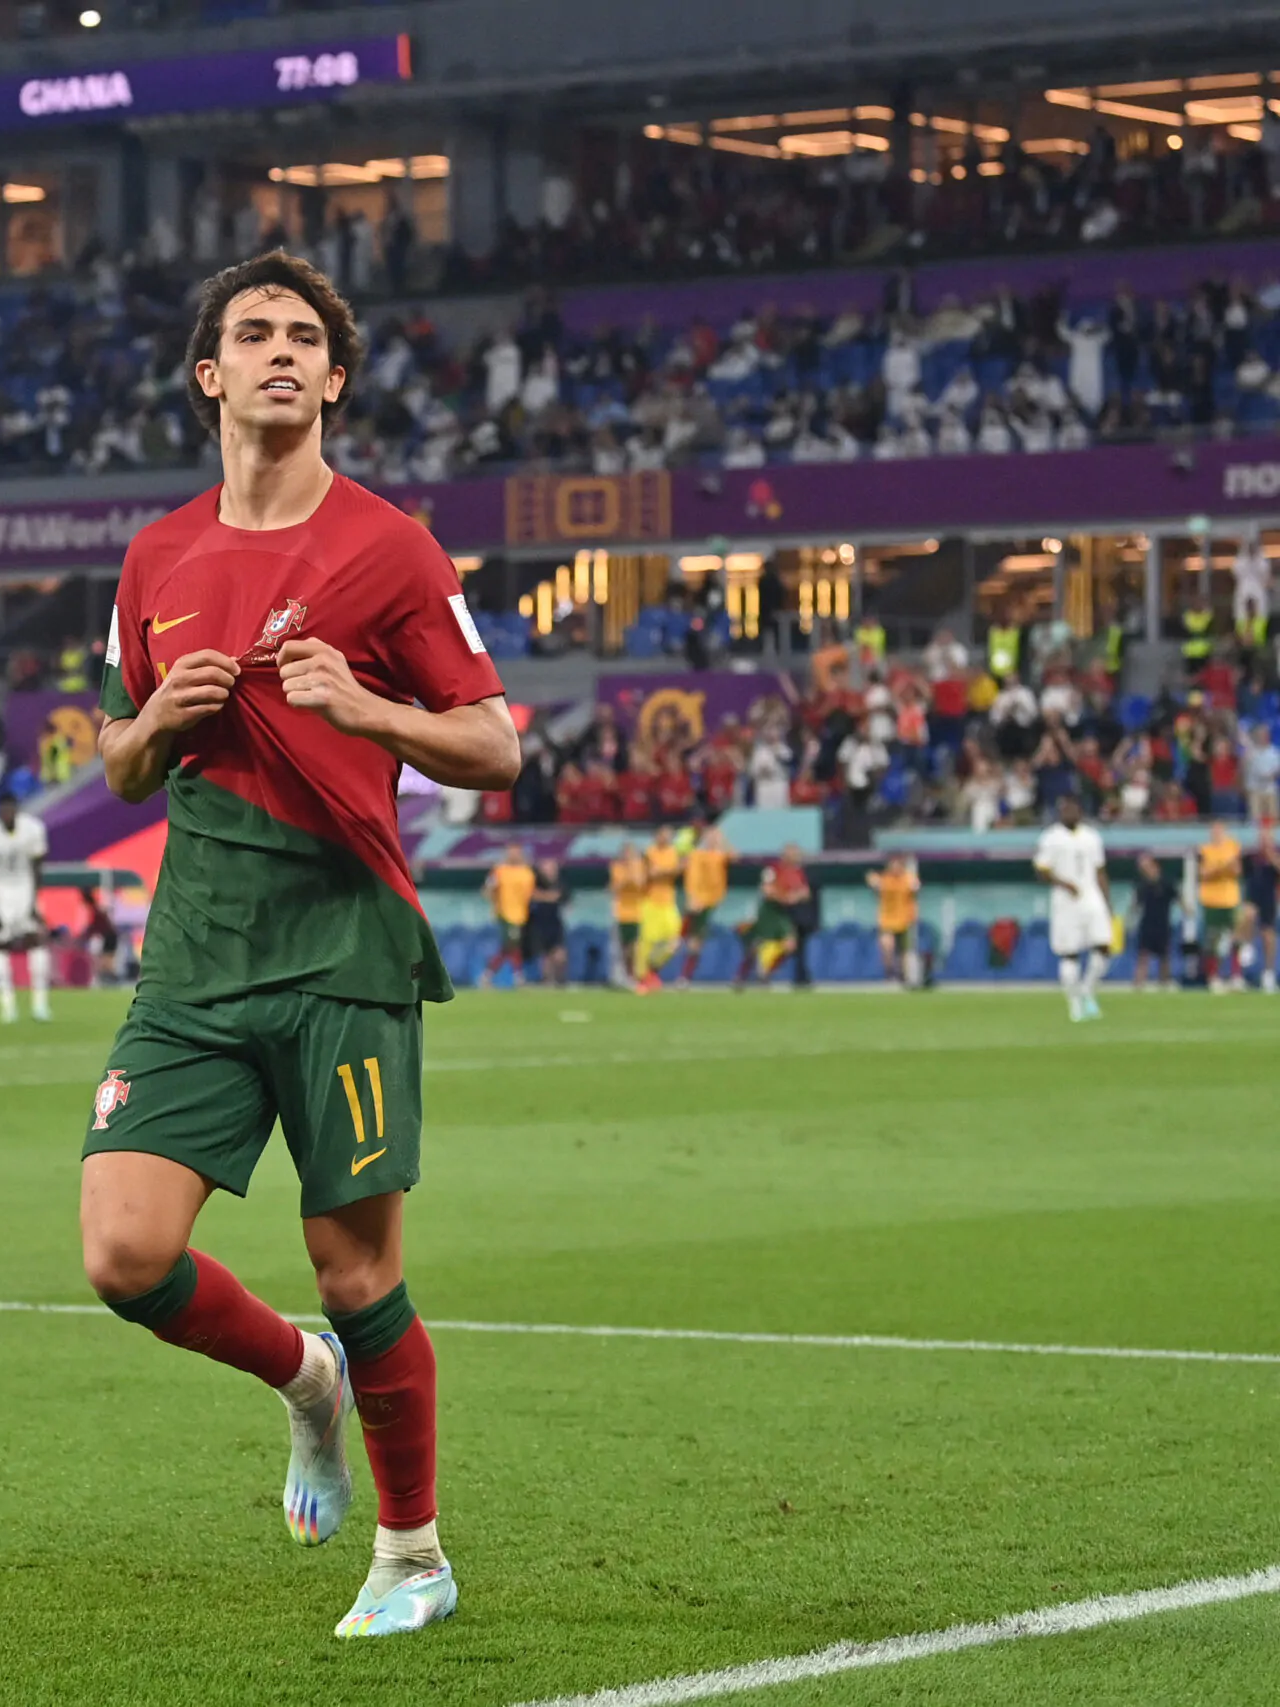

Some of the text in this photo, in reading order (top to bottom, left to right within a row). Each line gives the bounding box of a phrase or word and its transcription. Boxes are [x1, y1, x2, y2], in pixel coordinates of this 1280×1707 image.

[19, 71, 133, 116] GHANA
[1222, 463, 1280, 500] no
[337, 1057, 383, 1143] 11
